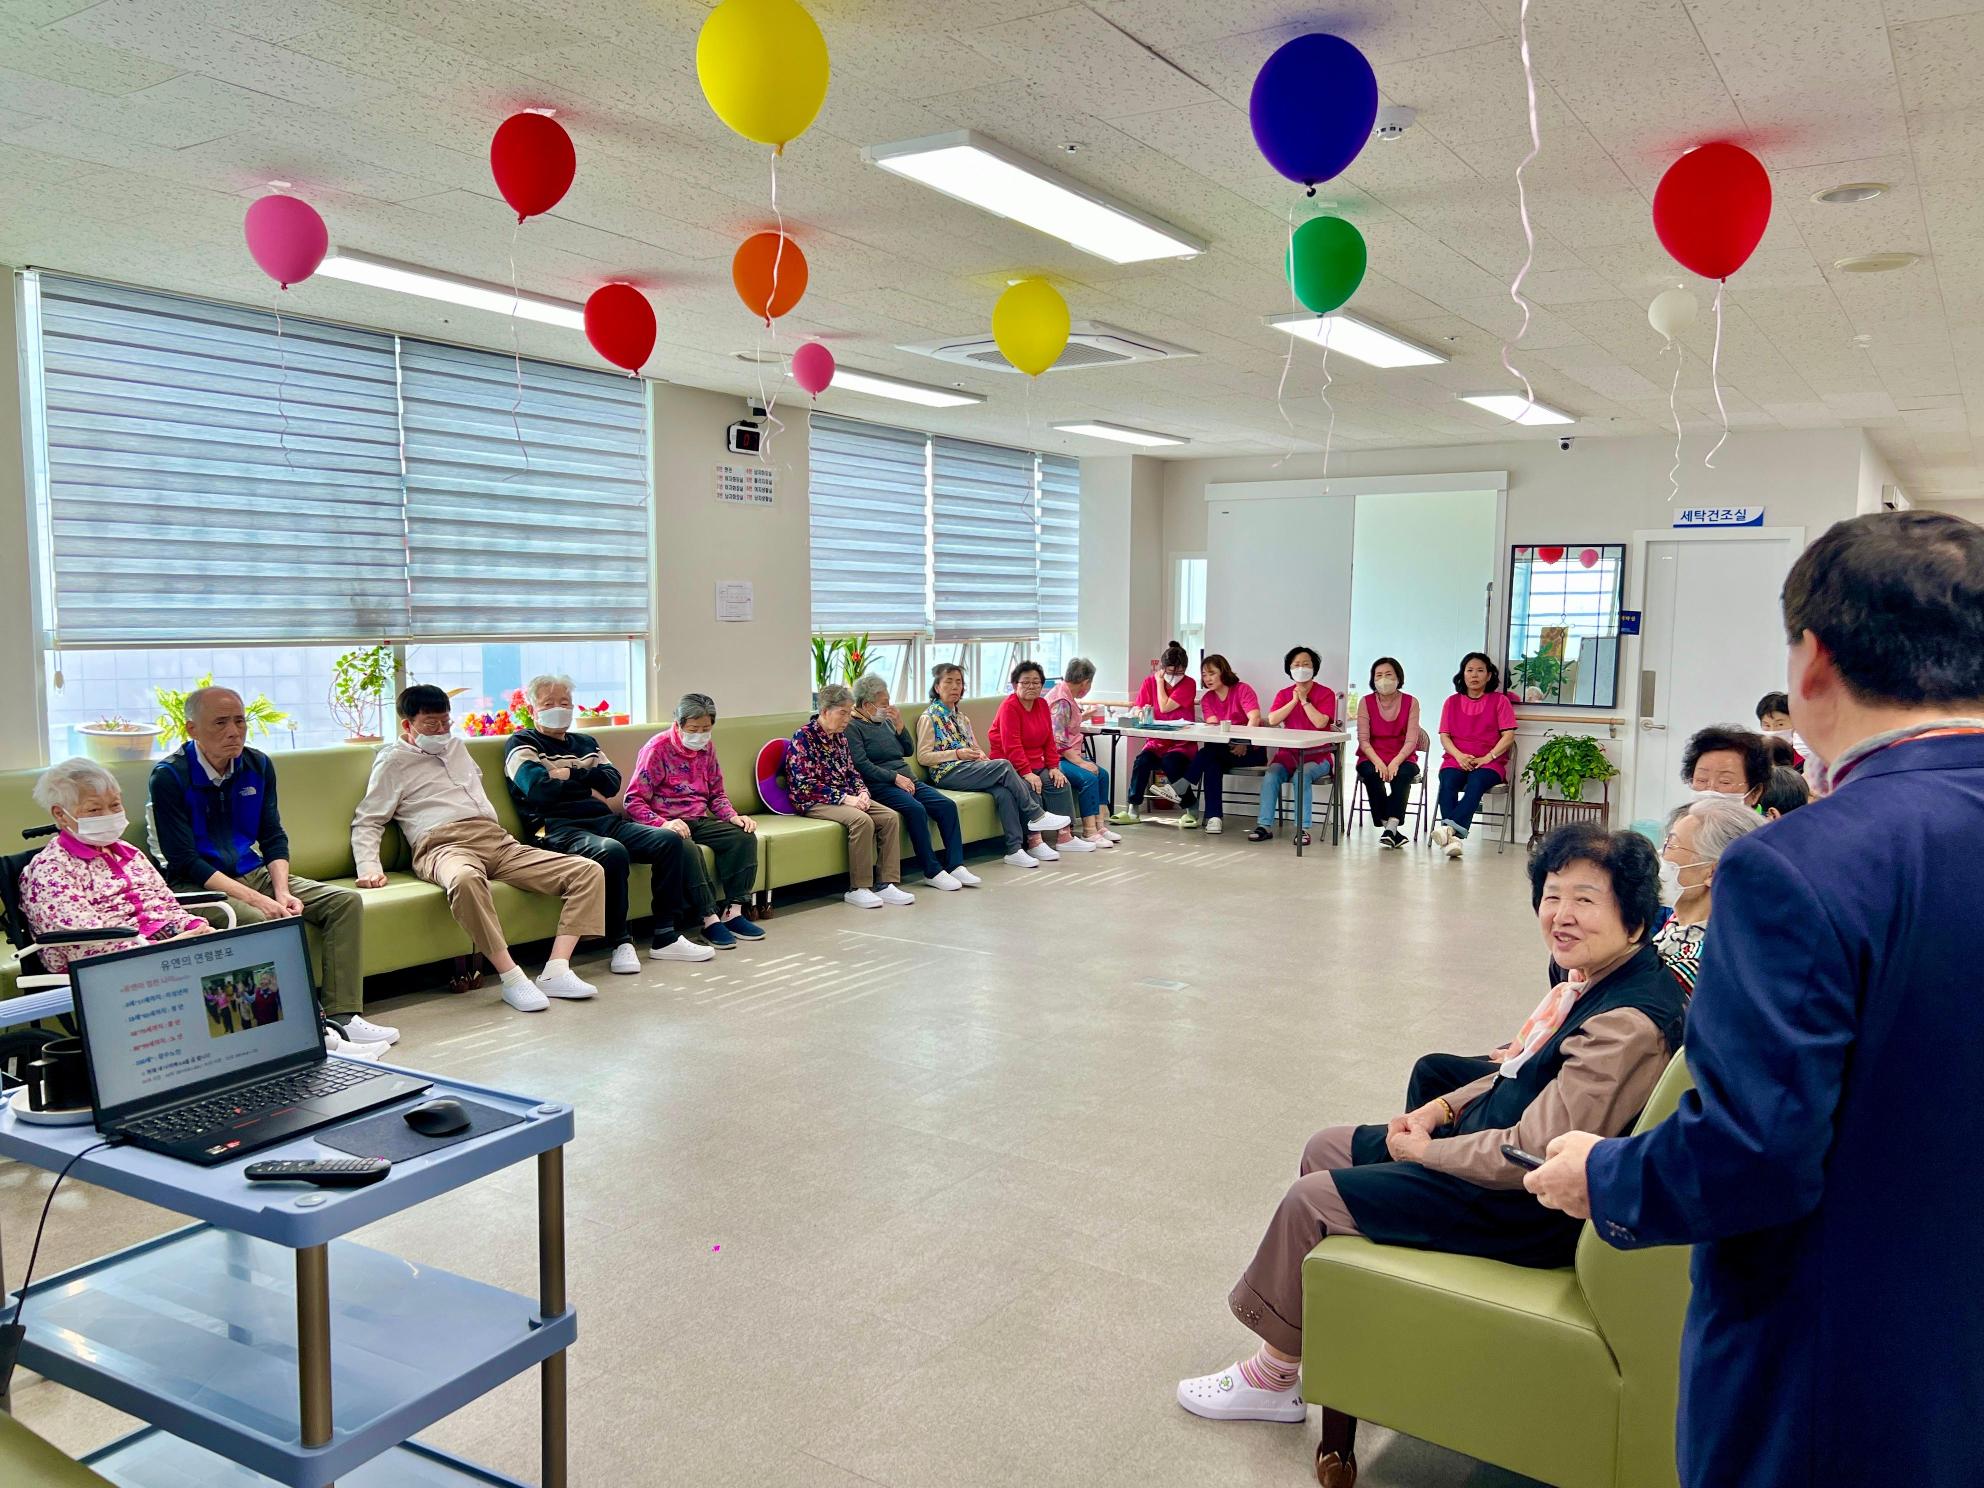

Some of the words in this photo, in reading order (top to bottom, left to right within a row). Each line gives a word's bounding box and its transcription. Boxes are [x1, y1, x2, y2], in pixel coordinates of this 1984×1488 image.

[1680, 508, 1748, 522] 세탁건조실
[160, 954, 192, 972] 유엔의
[194, 946, 235, 965] 연령분포
